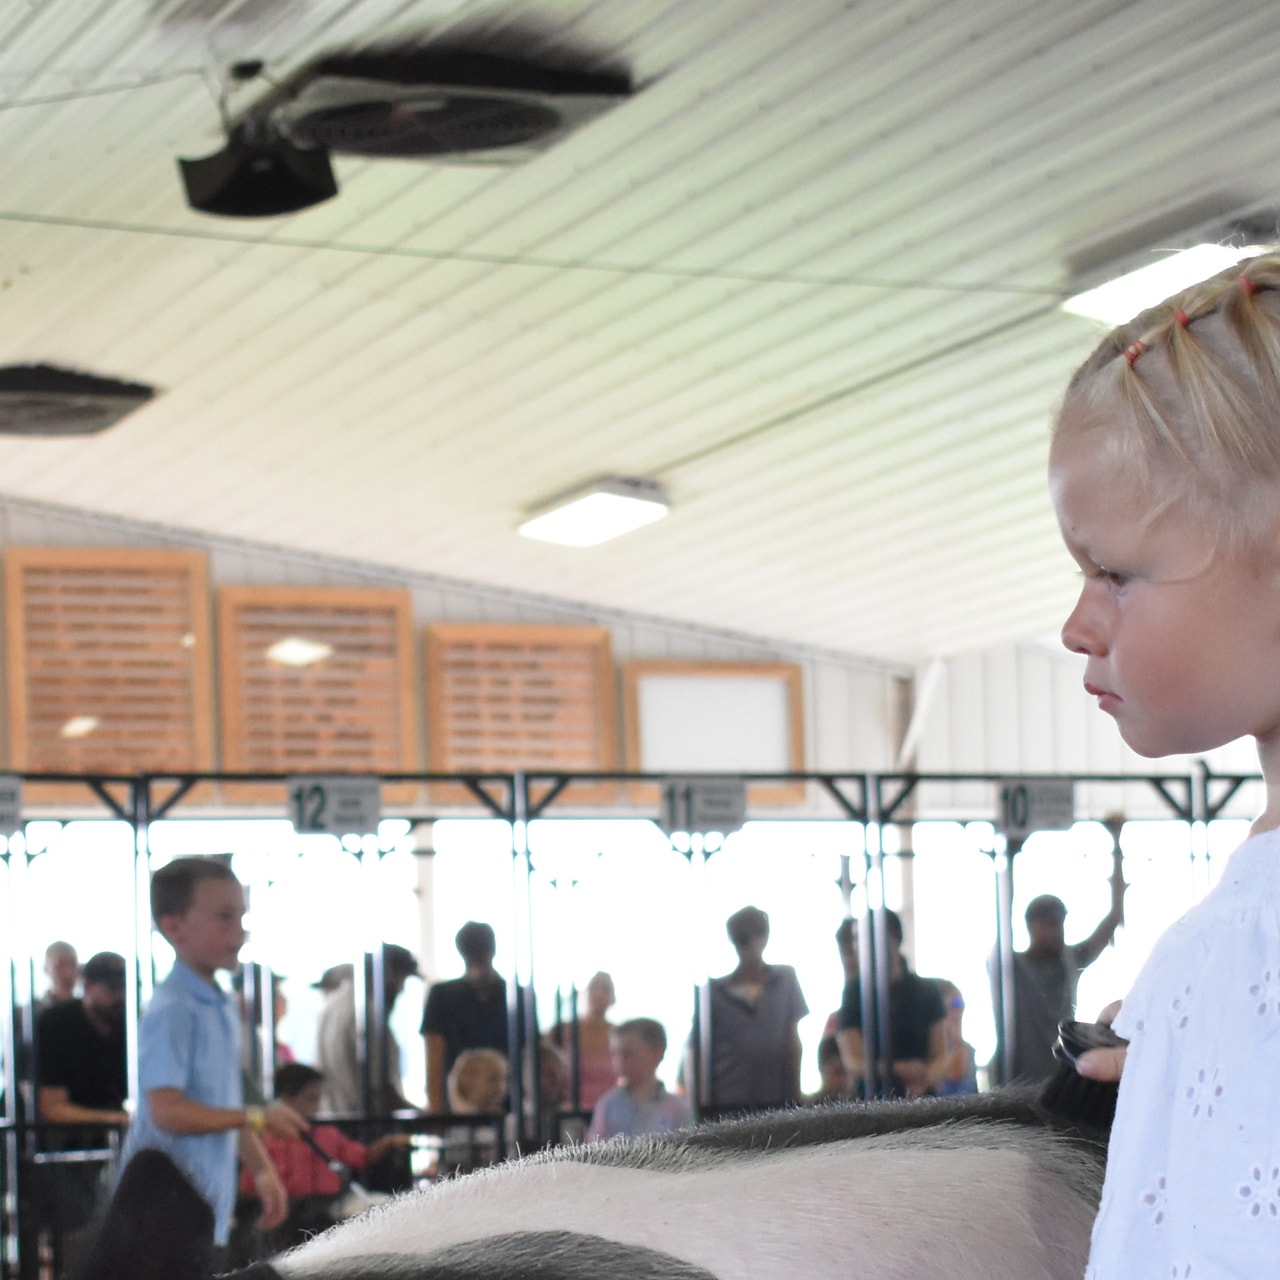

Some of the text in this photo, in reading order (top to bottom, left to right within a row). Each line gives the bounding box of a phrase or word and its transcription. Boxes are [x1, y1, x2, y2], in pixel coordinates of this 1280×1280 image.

[294, 785, 326, 831] 12
[664, 785, 693, 830] 11
[1002, 785, 1031, 829] 10
